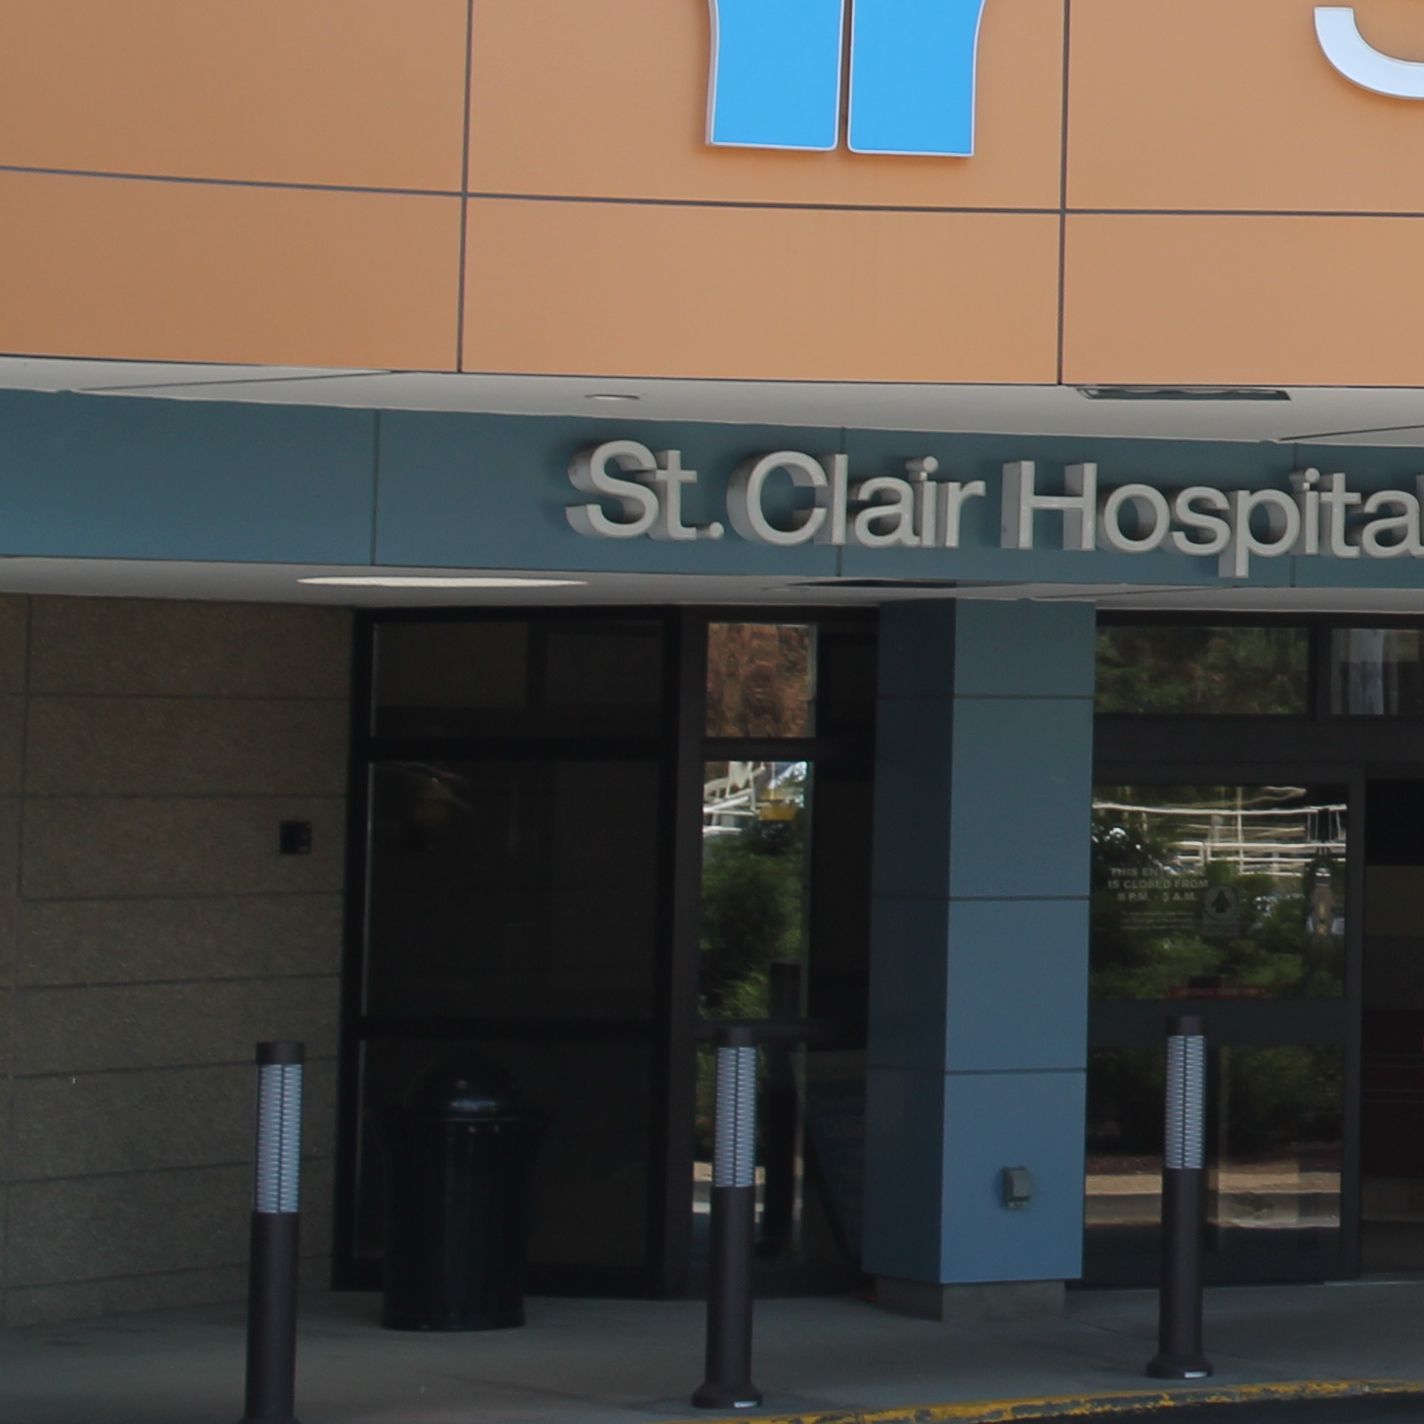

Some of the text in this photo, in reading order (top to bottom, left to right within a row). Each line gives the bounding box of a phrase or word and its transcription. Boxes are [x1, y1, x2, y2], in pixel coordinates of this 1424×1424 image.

[565, 439, 725, 542] St.
[726, 450, 986, 549] Clair
[1107, 879, 1209, 889] IS CLOSED FROM
